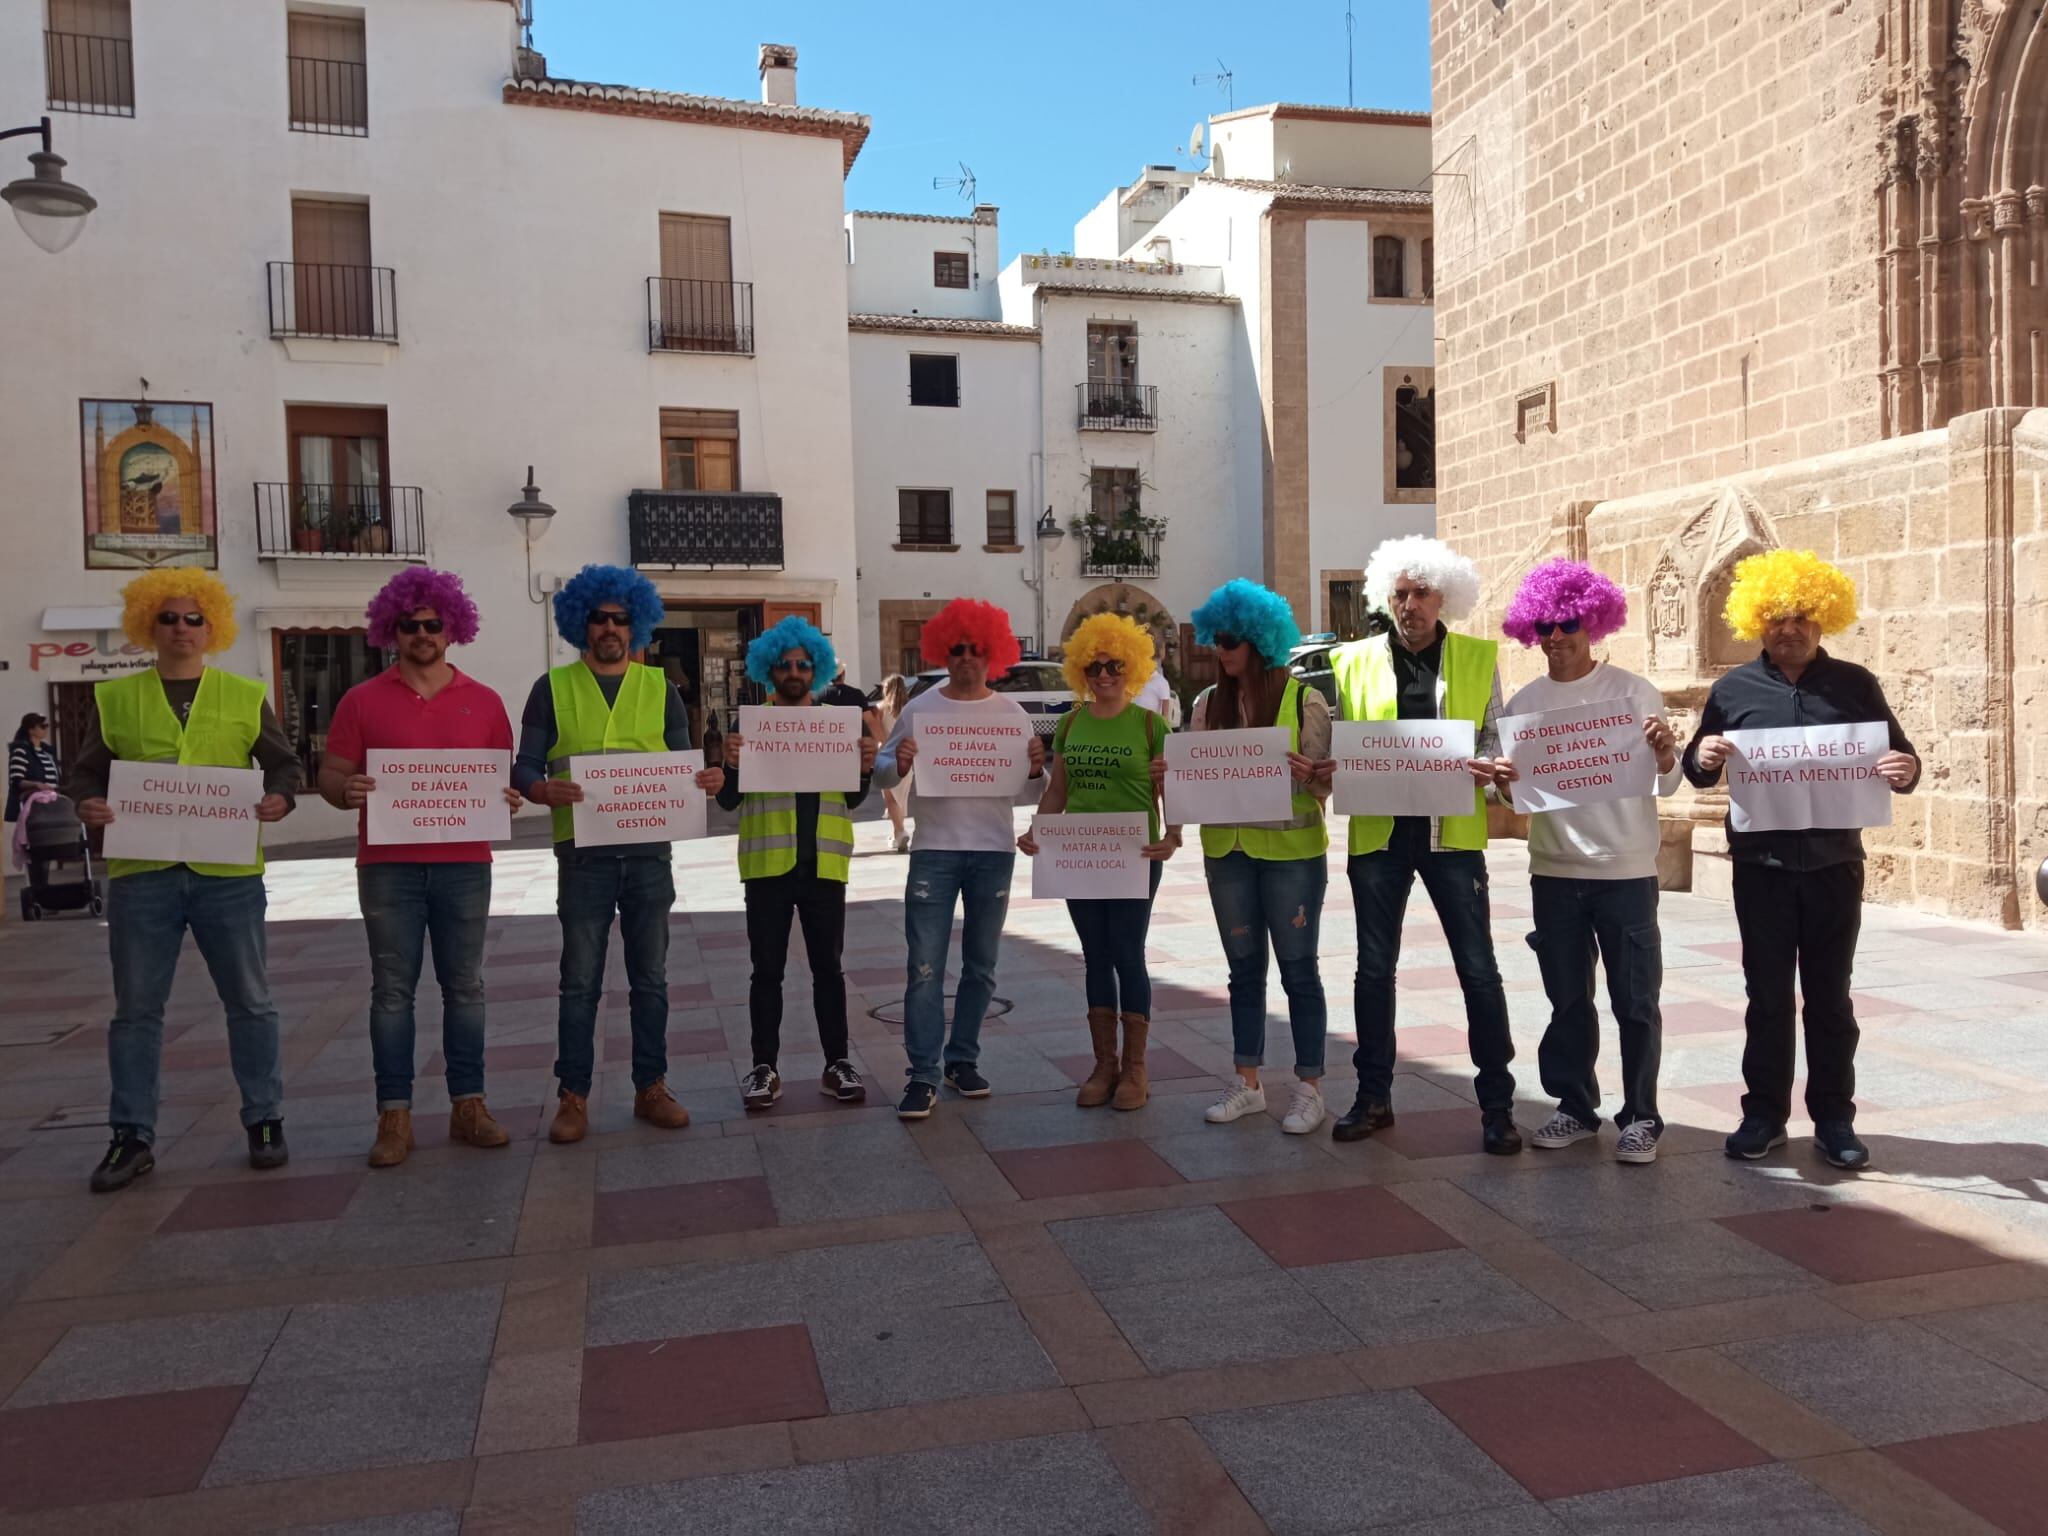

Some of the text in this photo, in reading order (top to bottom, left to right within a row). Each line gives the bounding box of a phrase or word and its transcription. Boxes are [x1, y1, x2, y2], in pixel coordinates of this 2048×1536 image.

[757, 721, 772, 733] JA
[829, 722, 845, 733] DE
[925, 726, 1021, 736] LOS DELINCUENTES
[1513, 713, 1633, 741] LOS DELINCUENTES
[748, 740, 854, 753] TANTA MENTIDA
[950, 739, 997, 752] DE JÁVEA
[1362, 735, 1443, 749] CHULVI NO
[1546, 737, 1606, 755] DE JÁVEA
[1190, 744, 1264, 759] CHULVI NO
[1748, 746, 1766, 760] JA
[1844, 742, 1866, 755] DE
[382, 763, 497, 774] LOS DELINCUENTES
[933, 757, 1012, 767] AGRADECEN TU
[1064, 756, 1120, 768] OLICIA
[1342, 759, 1464, 772] TIENES PALABRA
[1532, 752, 1631, 776] AGRADECEN TU
[585, 764, 693, 779] LOS DELINCUENTES
[950, 770, 995, 783] GESTIÓN
[1175, 766, 1282, 781] TIENES PALABRA
[1738, 766, 1879, 784] TANTA MENTIDA
[143, 778, 230, 797] CHULVI NO
[412, 778, 468, 792] DE JÁVEA
[614, 780, 667, 794] DE JÁVEA
[1557, 772, 1613, 791] GESTIÓN
[120, 800, 249, 820] TIENES PALABRA
[392, 798, 487, 810] AGRADECEN TU
[596, 799, 685, 813] AGRADECEN TU
[413, 814, 466, 827] GESTIÓN
[616, 814, 666, 828] GESTIÓN
[1040, 827, 1142, 836] CHULVI CULPABLE DE
[1062, 843, 1121, 852] MATAR A LA
[1056, 859, 1126, 869] POLICIA LOCAL
